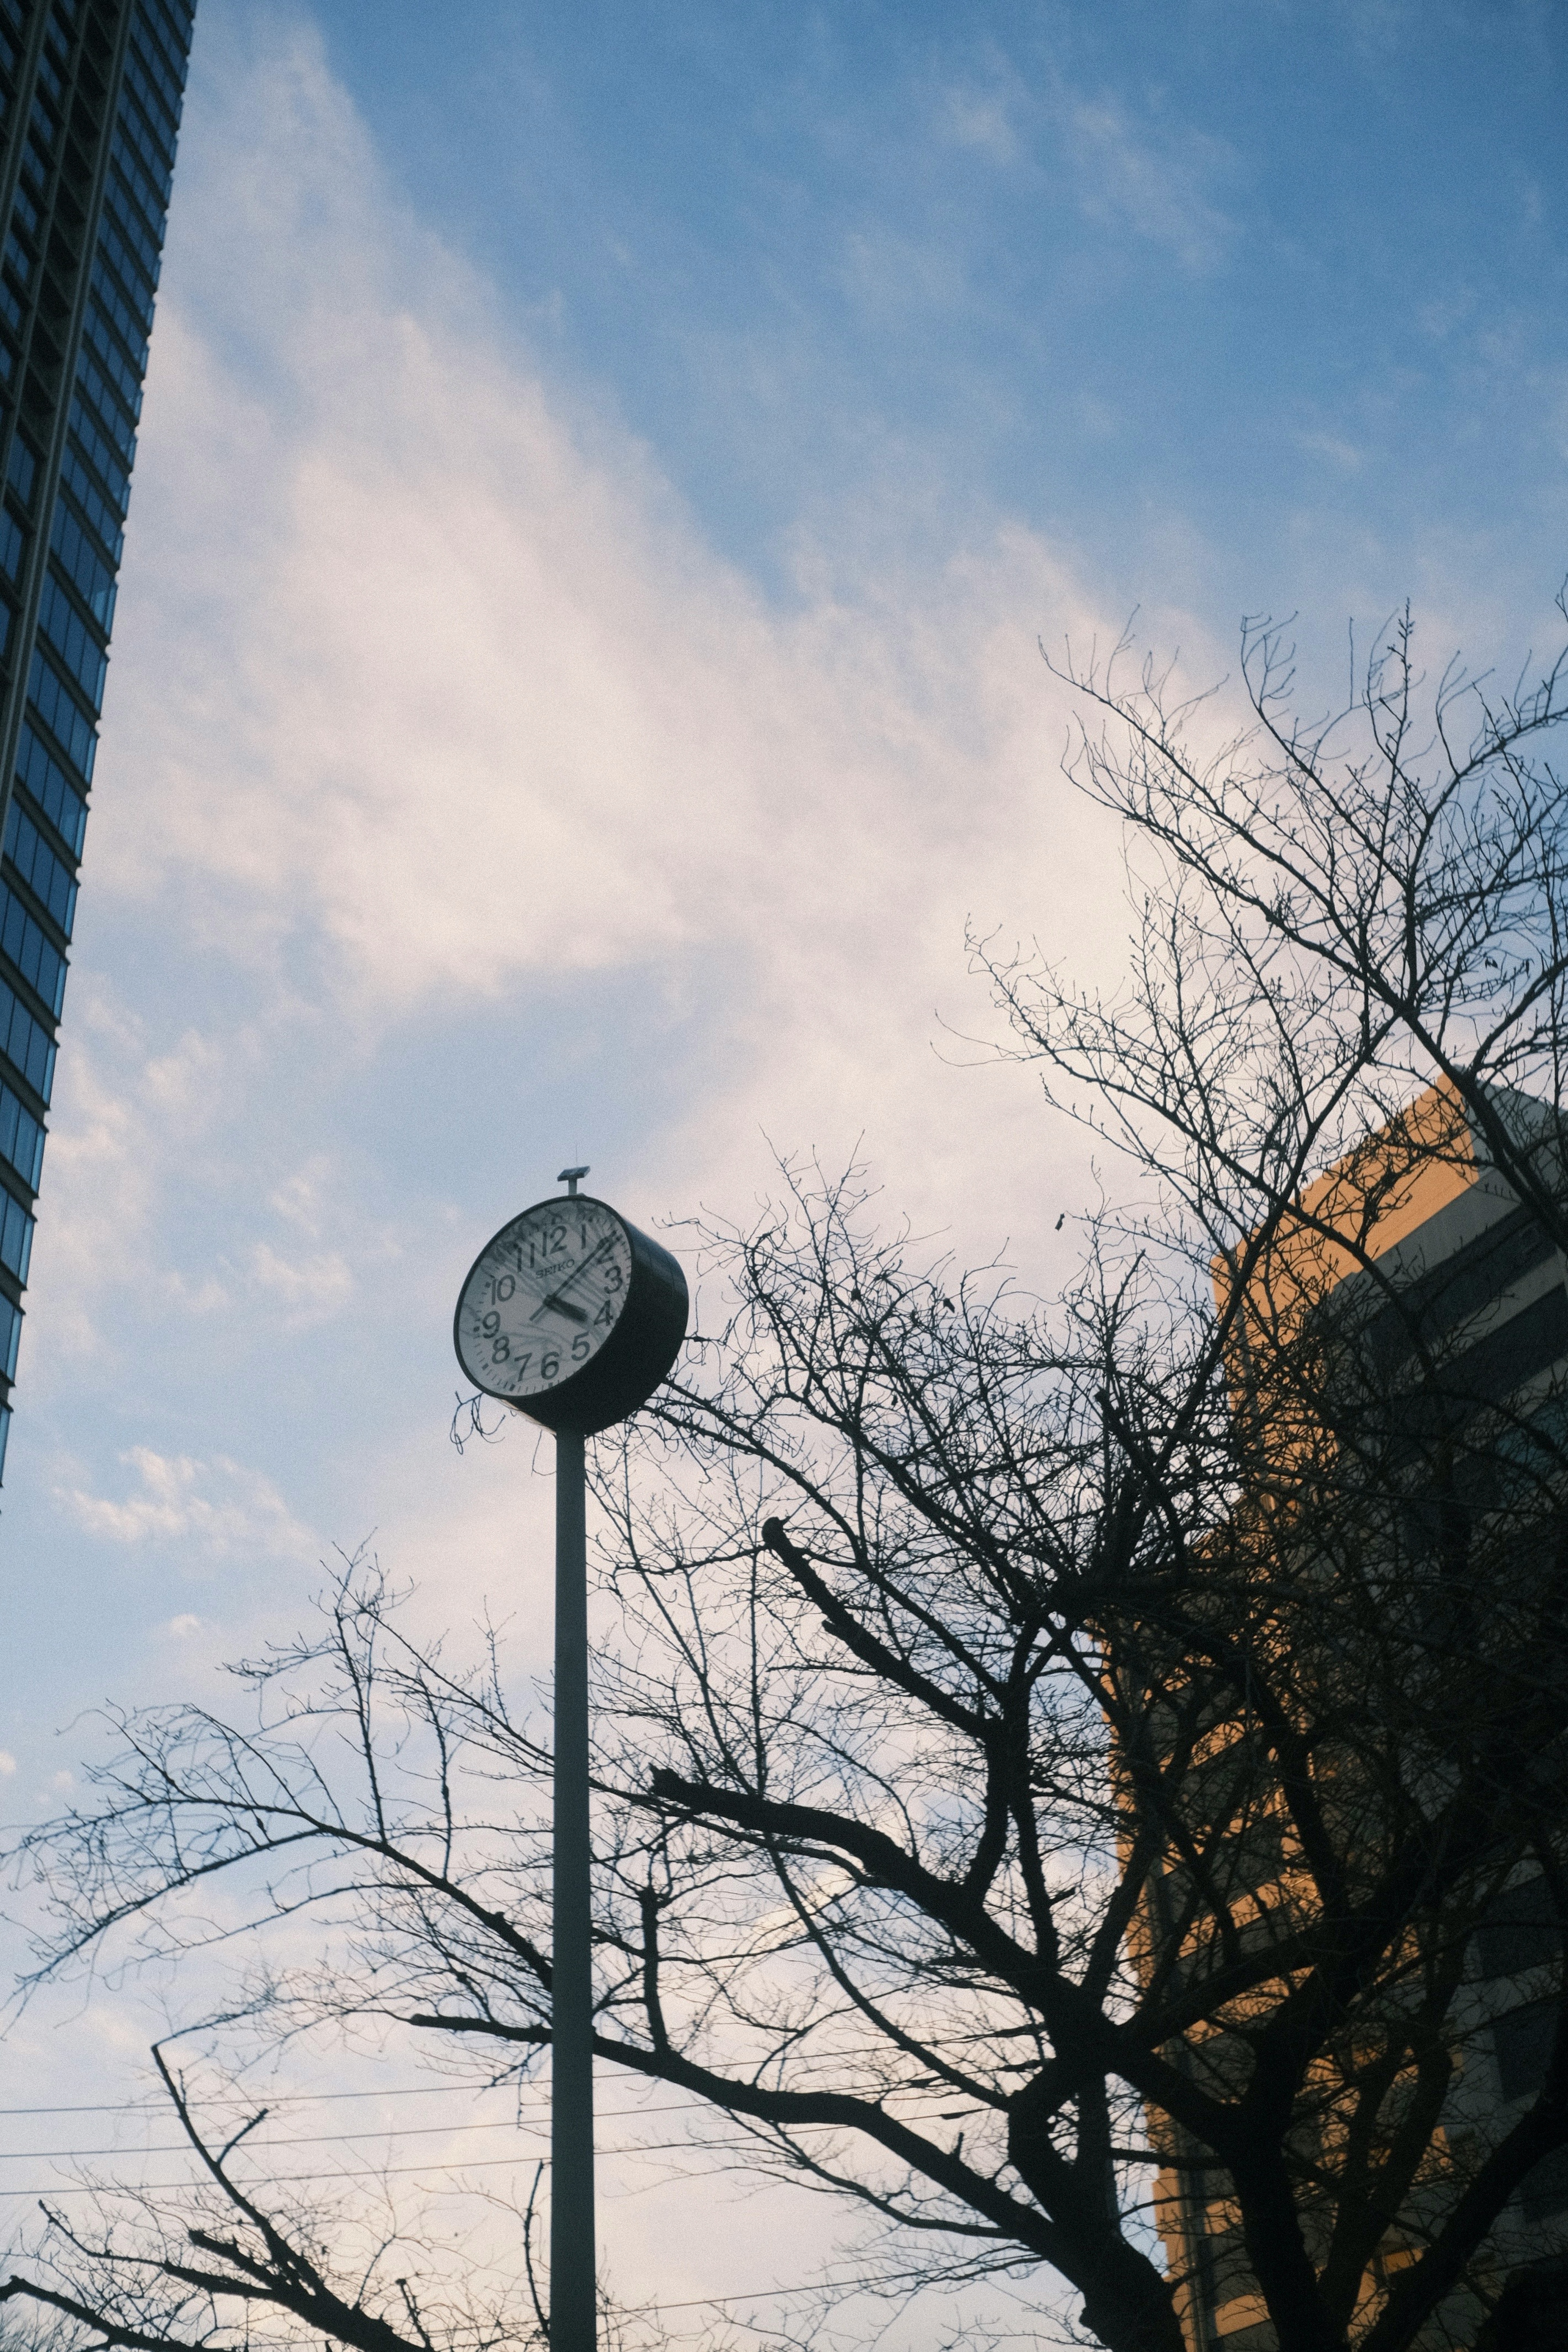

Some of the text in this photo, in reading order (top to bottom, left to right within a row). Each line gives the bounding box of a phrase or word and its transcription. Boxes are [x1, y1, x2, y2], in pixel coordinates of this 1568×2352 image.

[542, 1225, 567, 1257] 12
[581, 1224, 587, 1250] 1
[517, 1242, 535, 1272] 11
[535, 1259, 575, 1279] SEIKO
[491, 1274, 516, 1305] 10
[604, 1265, 623, 1294] 3
[482, 1311, 501, 1339] 9
[594, 1300, 613, 1326] 4
[492, 1336, 510, 1364] 8
[572, 1331, 590, 1361] 5
[514, 1353, 532, 1382] 7
[541, 1352, 559, 1380] 6
